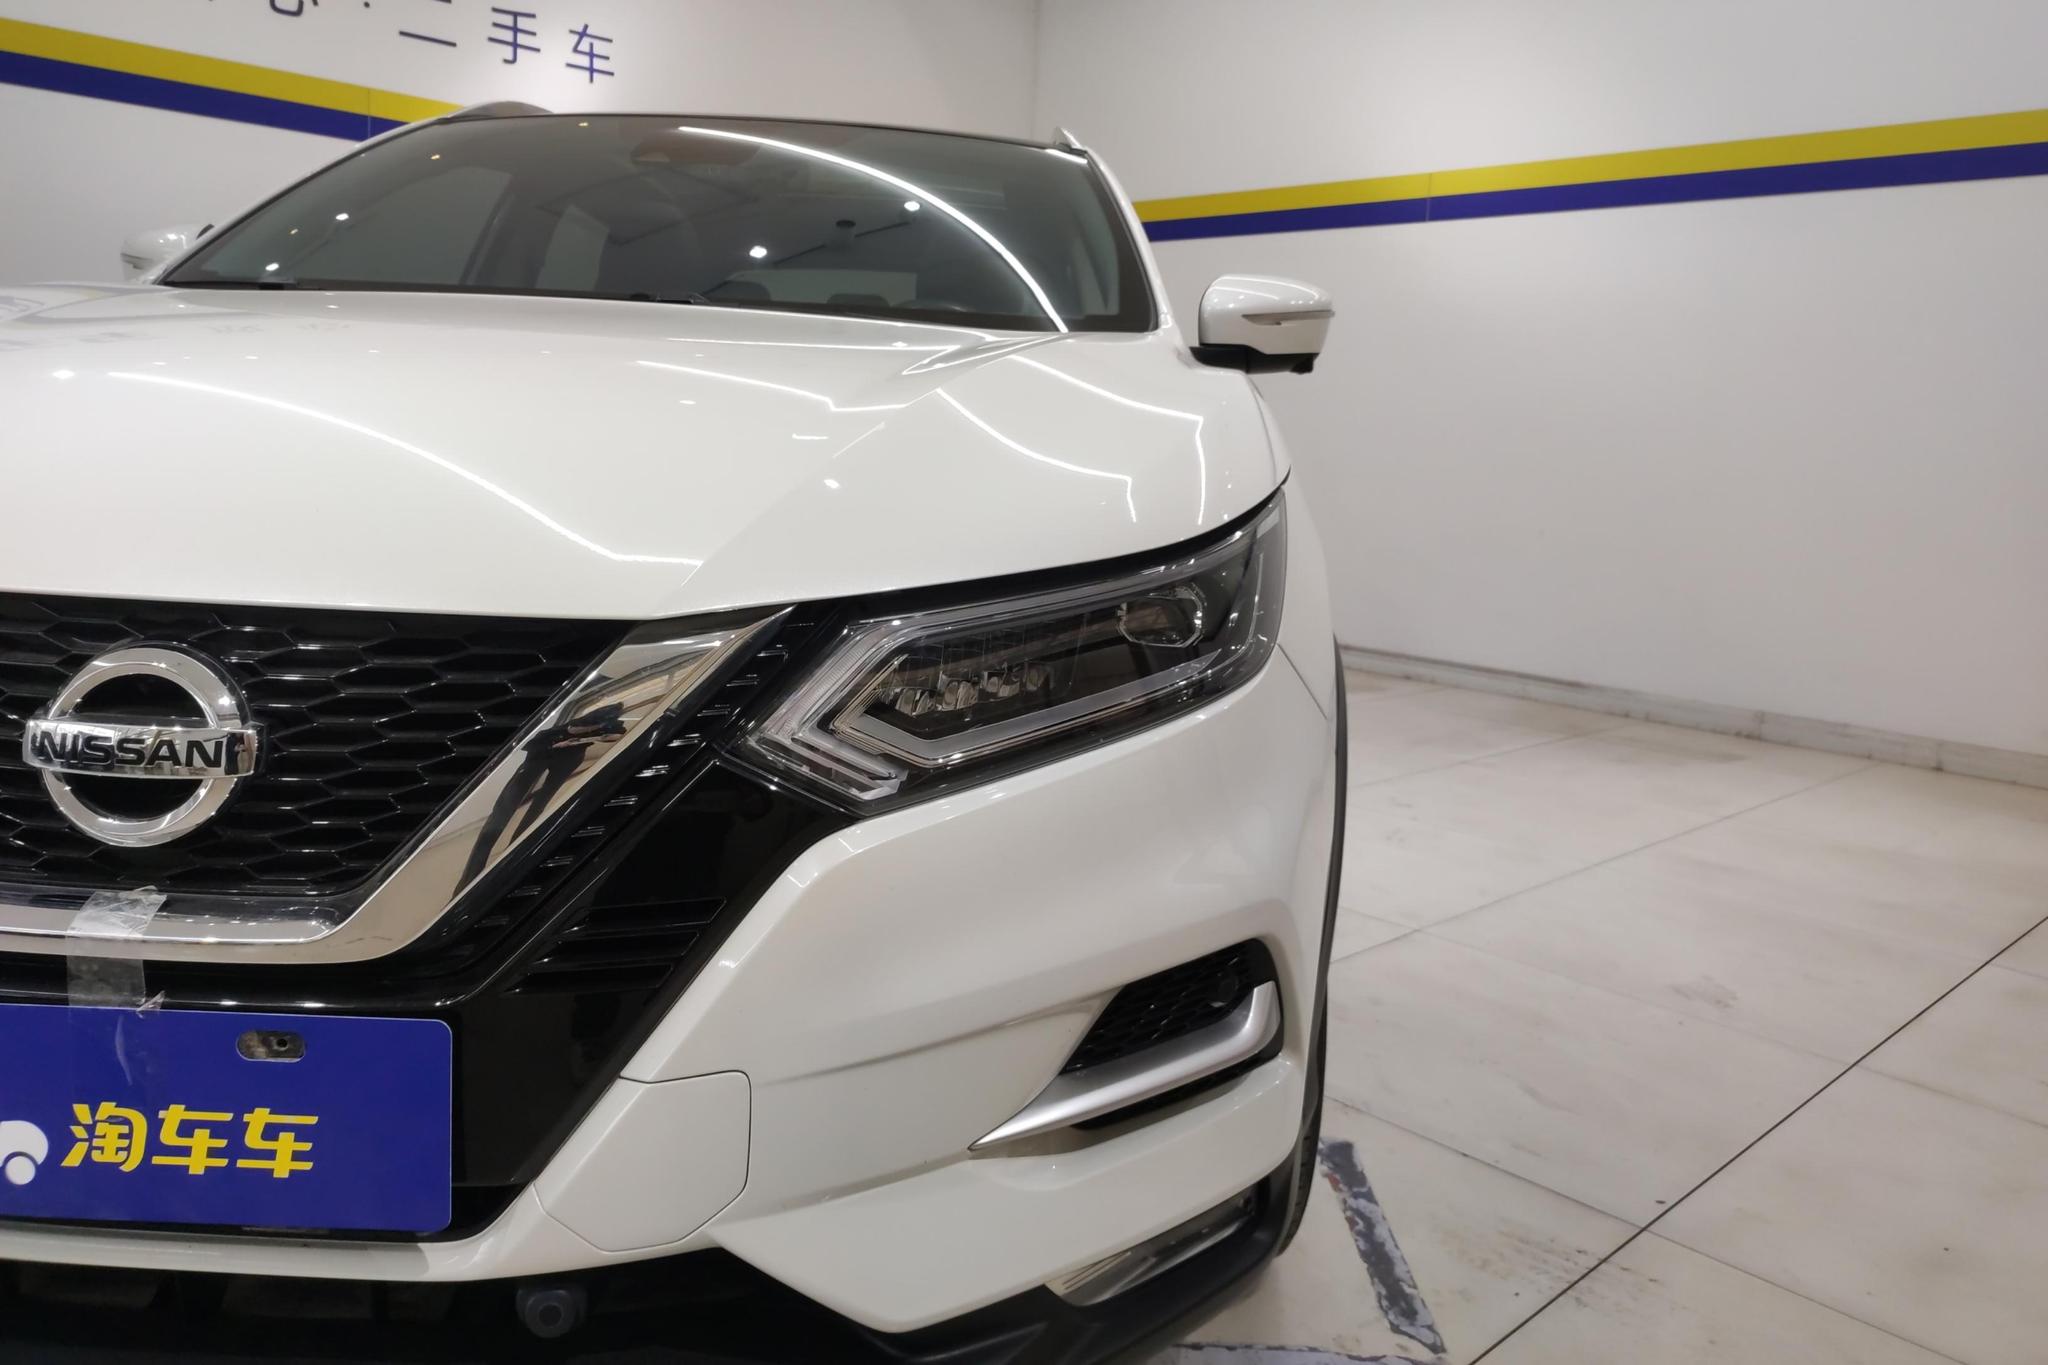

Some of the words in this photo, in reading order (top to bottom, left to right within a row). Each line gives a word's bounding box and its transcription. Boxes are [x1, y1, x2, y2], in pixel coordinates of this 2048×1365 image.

[31, 730, 224, 769] NISSAN
[60, 1101, 319, 1178] 淘车车
